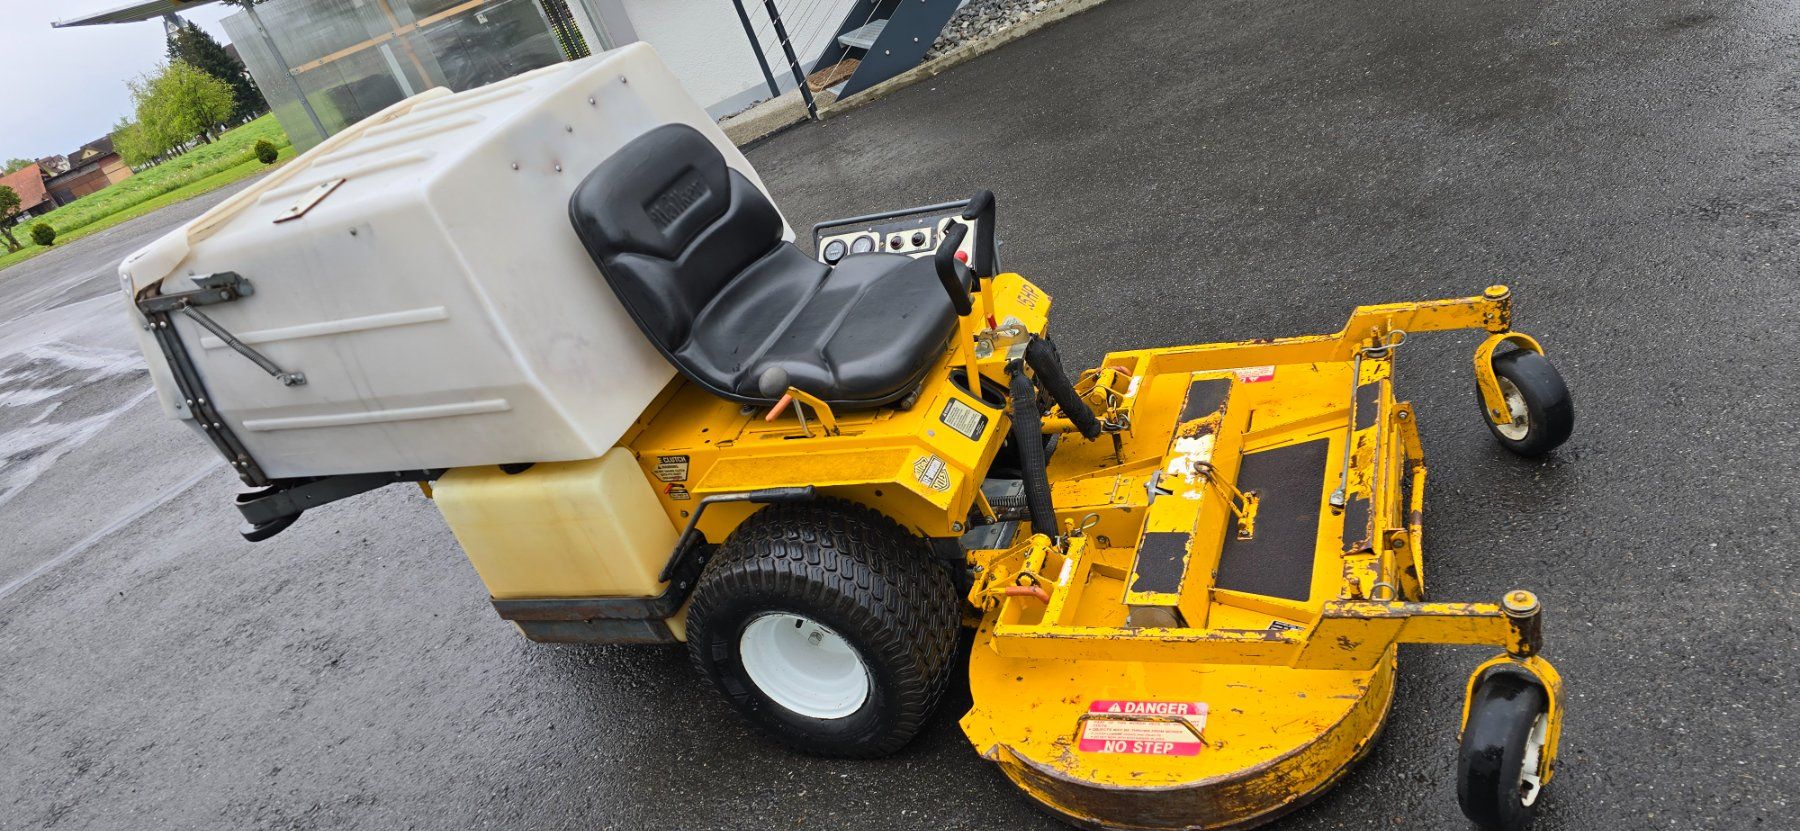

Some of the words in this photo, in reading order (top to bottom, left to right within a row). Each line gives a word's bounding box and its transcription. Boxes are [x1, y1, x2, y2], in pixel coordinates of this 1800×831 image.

[1125, 702, 1188, 715] DANGER
[1104, 740, 1127, 753] NO
[1132, 742, 1174, 755] STEP
